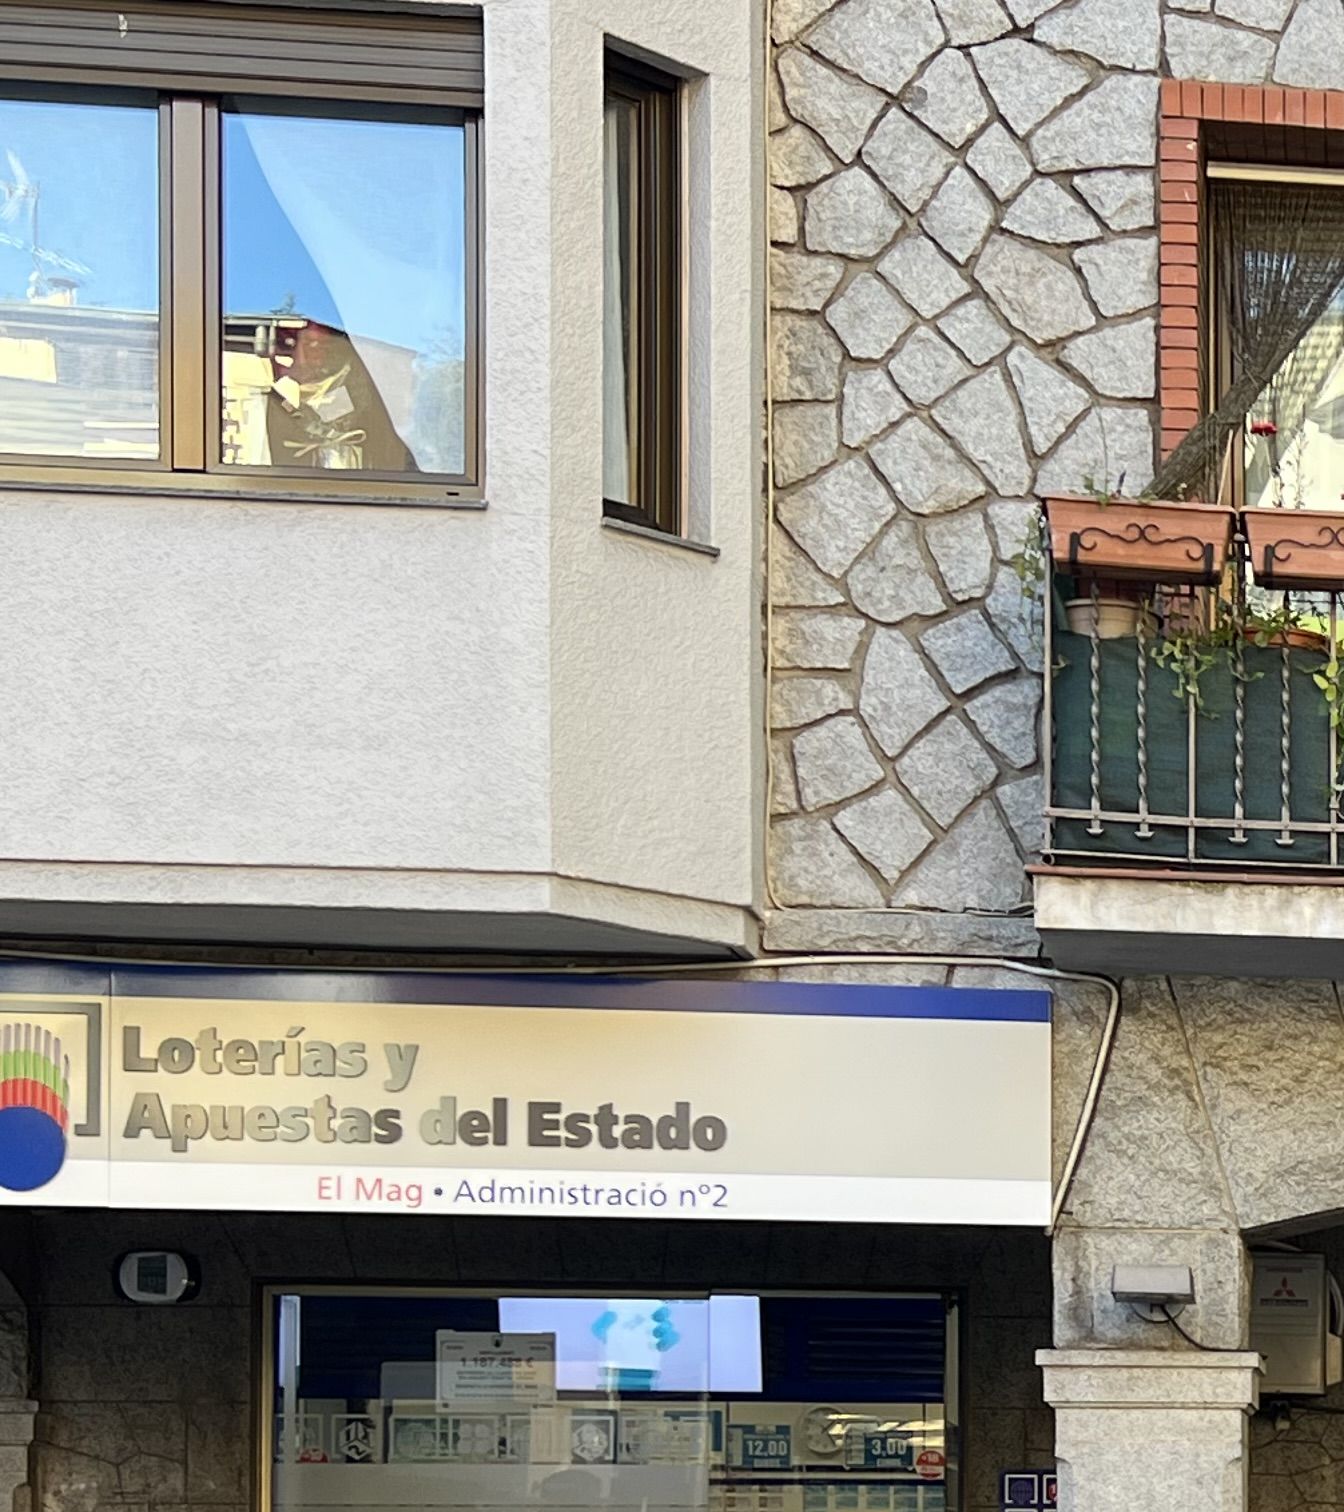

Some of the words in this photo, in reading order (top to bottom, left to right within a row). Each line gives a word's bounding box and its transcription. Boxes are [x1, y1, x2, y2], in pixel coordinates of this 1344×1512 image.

[123, 1026, 367, 1078] Loterías
[383, 1043, 419, 1092] y
[122, 1092, 402, 1152] Apuestas
[419, 1096, 508, 1146] del
[528, 1101, 727, 1151] Estado
[317, 1176, 342, 1199] El
[355, 1178, 422, 1208] Mag
[453, 1179, 667, 1207] Administració
[679, 1183, 728, 1207] nº2
